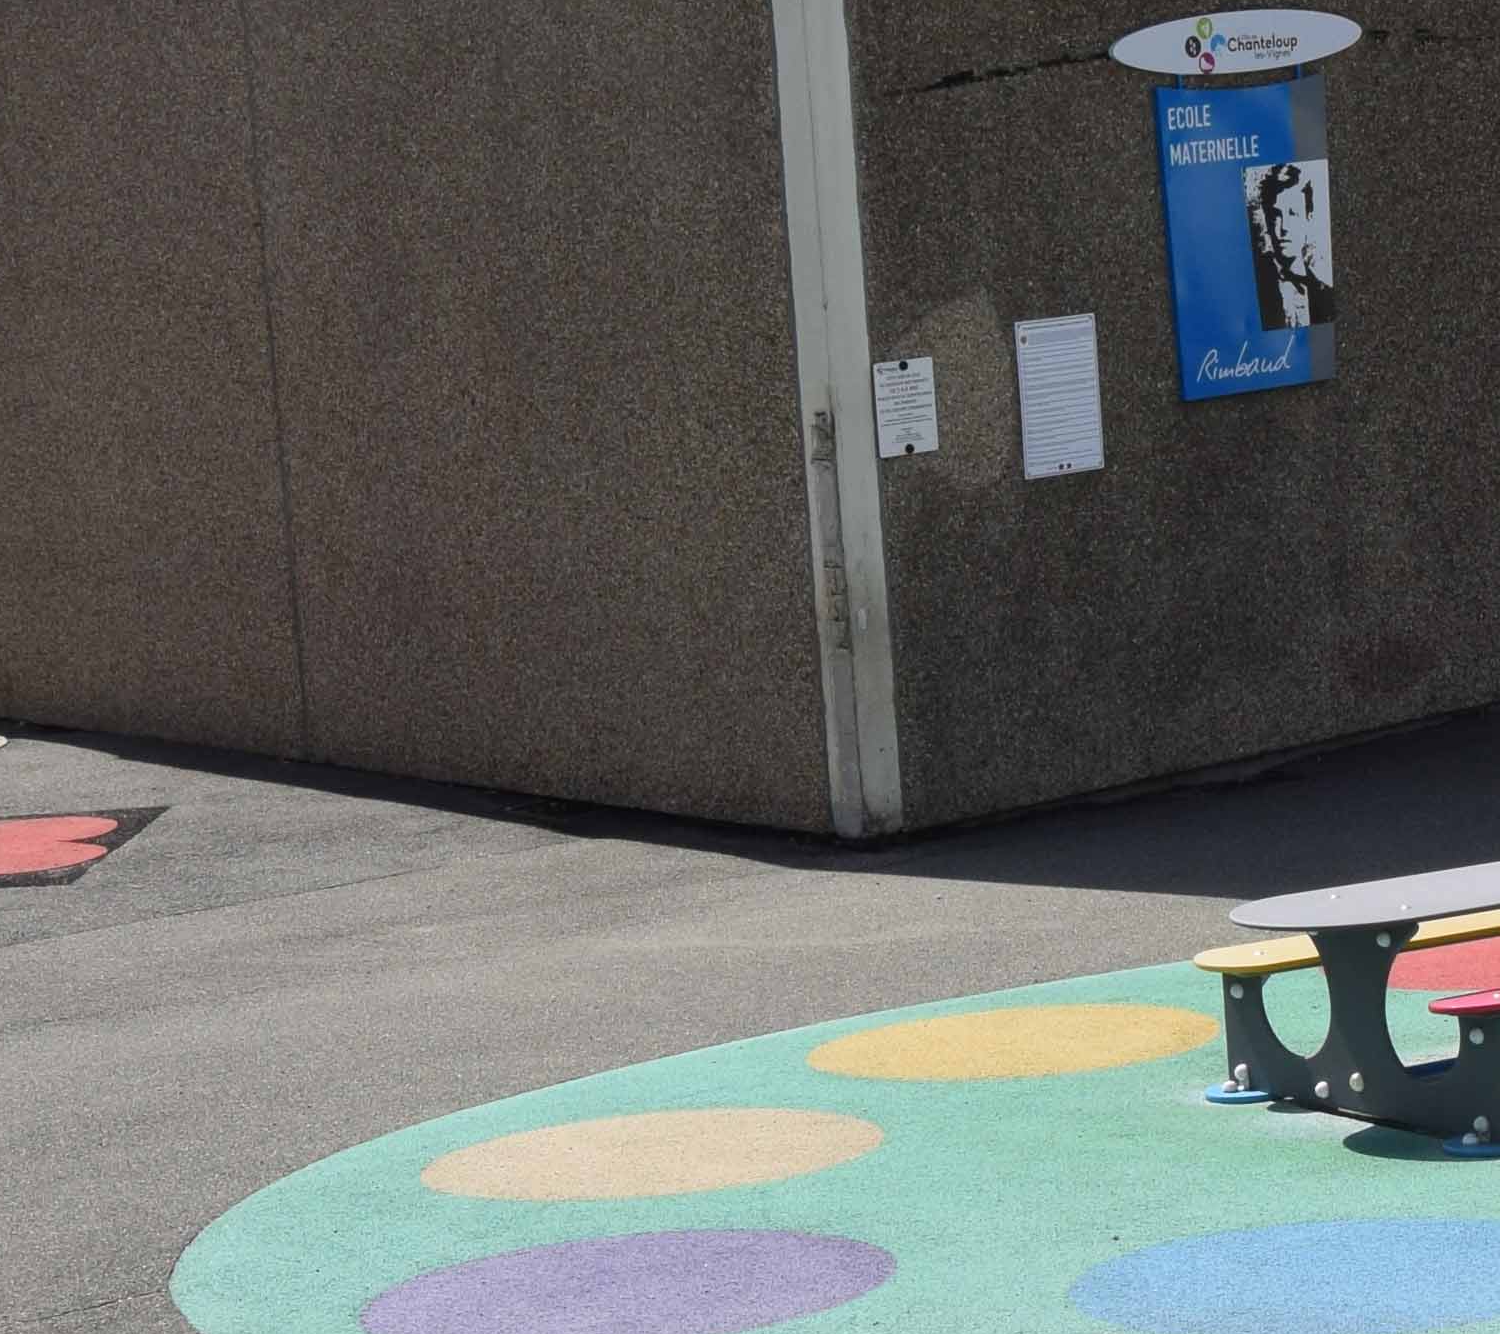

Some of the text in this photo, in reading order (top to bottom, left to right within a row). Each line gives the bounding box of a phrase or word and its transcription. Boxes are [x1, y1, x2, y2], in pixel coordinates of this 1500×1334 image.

[1227, 32, 1298, 52] Chanteloup
[1167, 105, 1211, 130] ECOLE
[1169, 134, 1260, 166] MATERNELLE
[1196, 334, 1296, 383] Rimbaud
